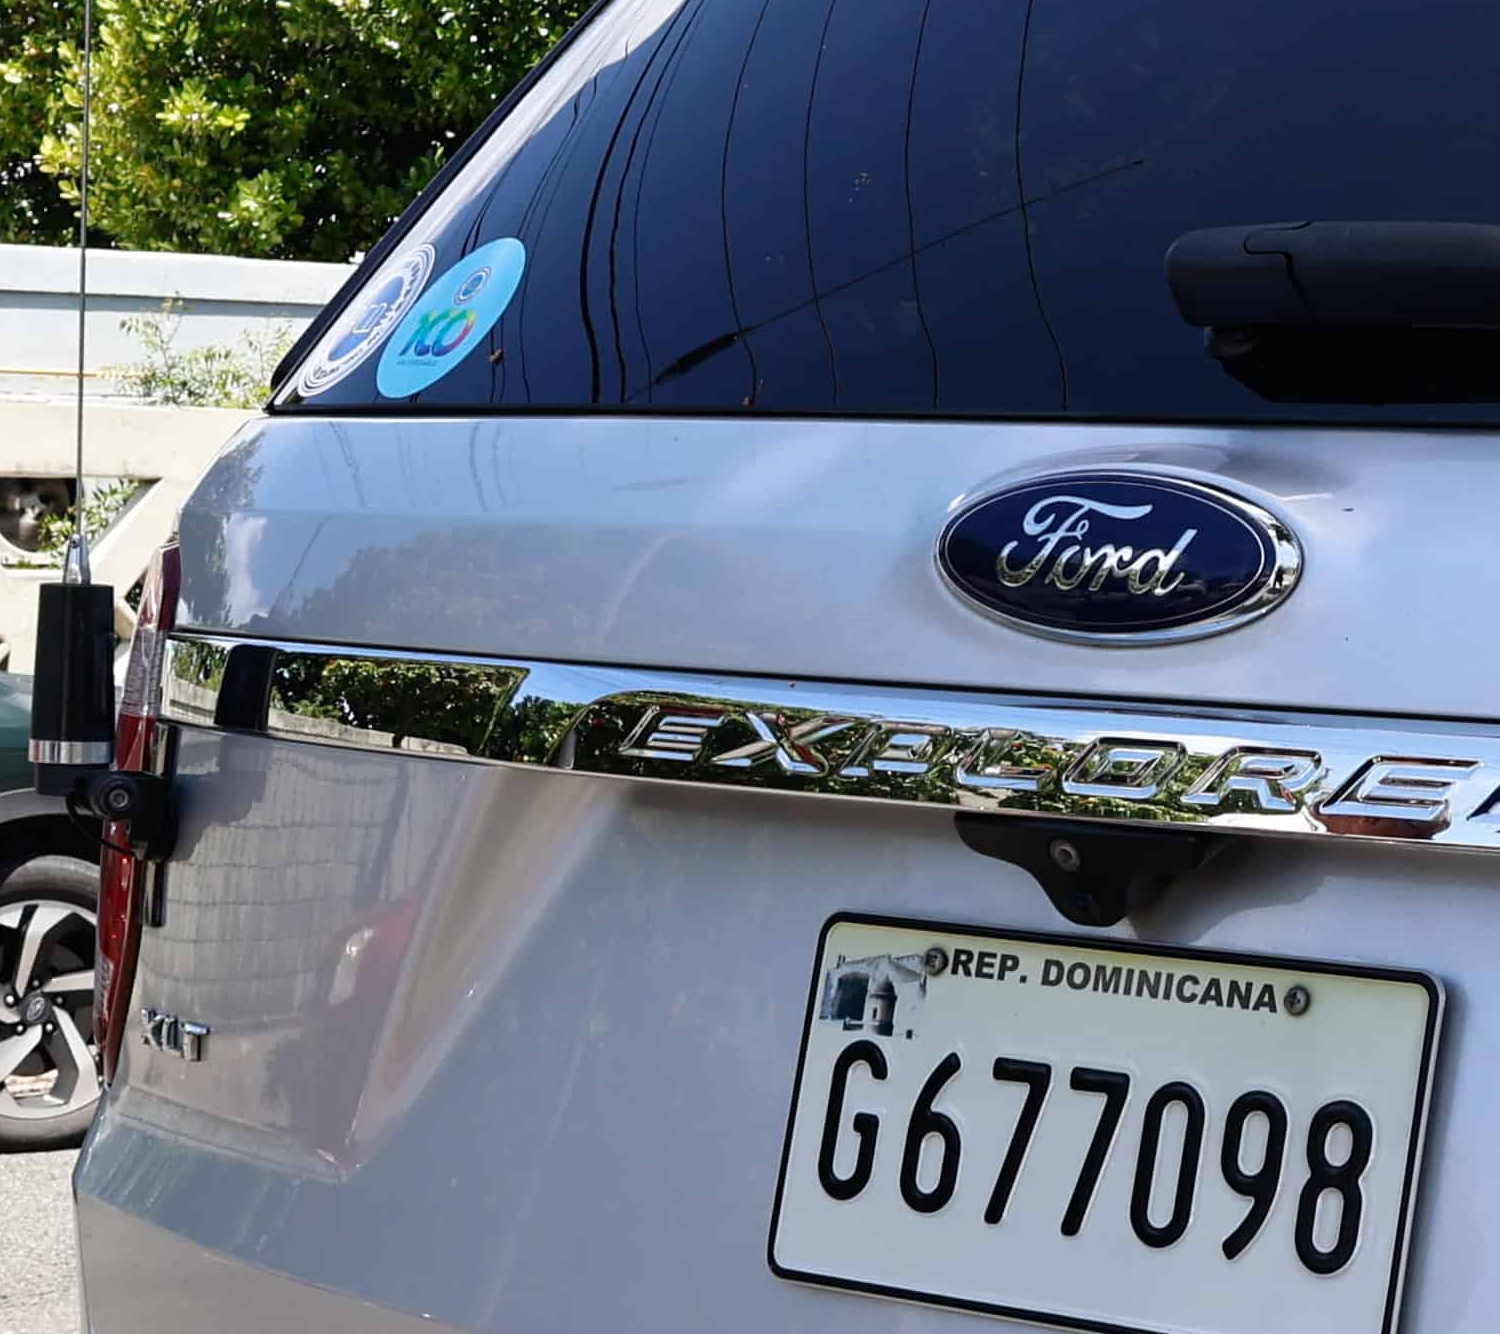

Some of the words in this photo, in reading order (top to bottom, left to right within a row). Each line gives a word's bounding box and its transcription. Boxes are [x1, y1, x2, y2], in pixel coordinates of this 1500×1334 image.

[998, 495, 1198, 597] Ford
[949, 948, 1028, 985] REP.
[1040, 958, 1278, 1014] DOMINICANA
[817, 1040, 1374, 1276] G677098
